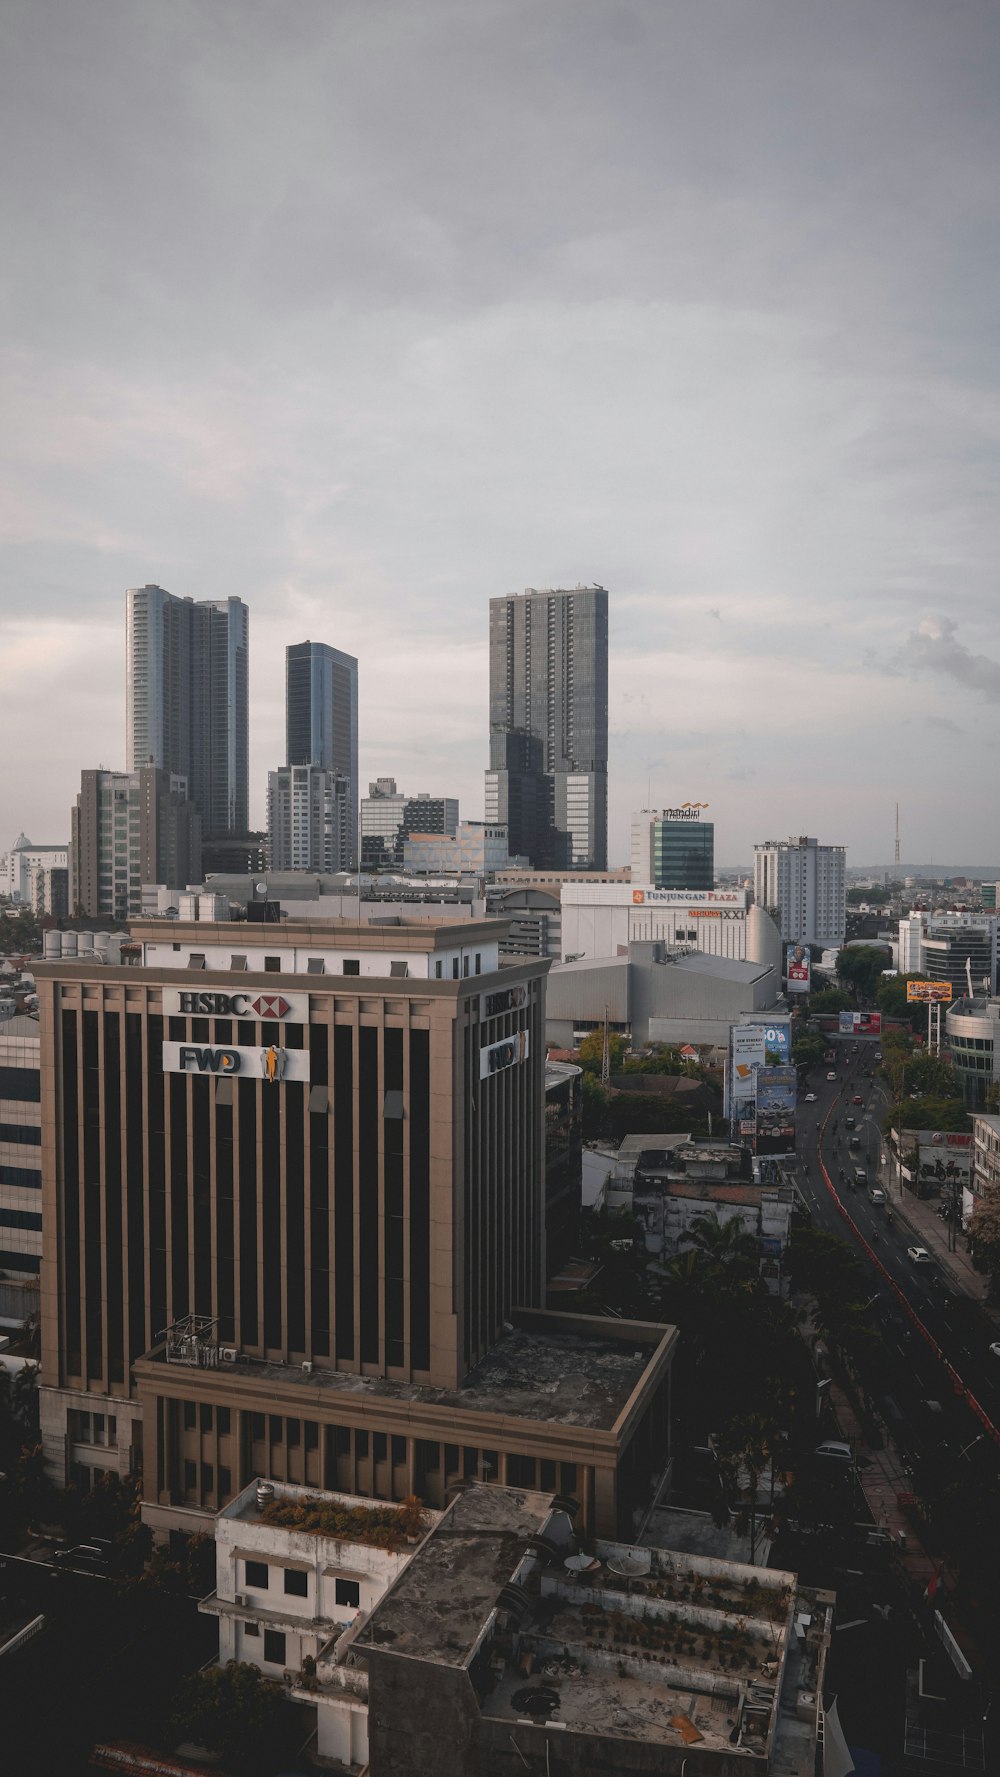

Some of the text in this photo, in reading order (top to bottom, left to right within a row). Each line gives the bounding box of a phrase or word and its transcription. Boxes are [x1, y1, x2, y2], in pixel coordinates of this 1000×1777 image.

[662, 807, 700, 817] mandiri
[646, 891, 737, 902] TUNJUNGAN PLAZA
[723, 910, 745, 920] XXI
[178, 991, 248, 1016] HSBC
[179, 1046, 241, 1073] FWD
